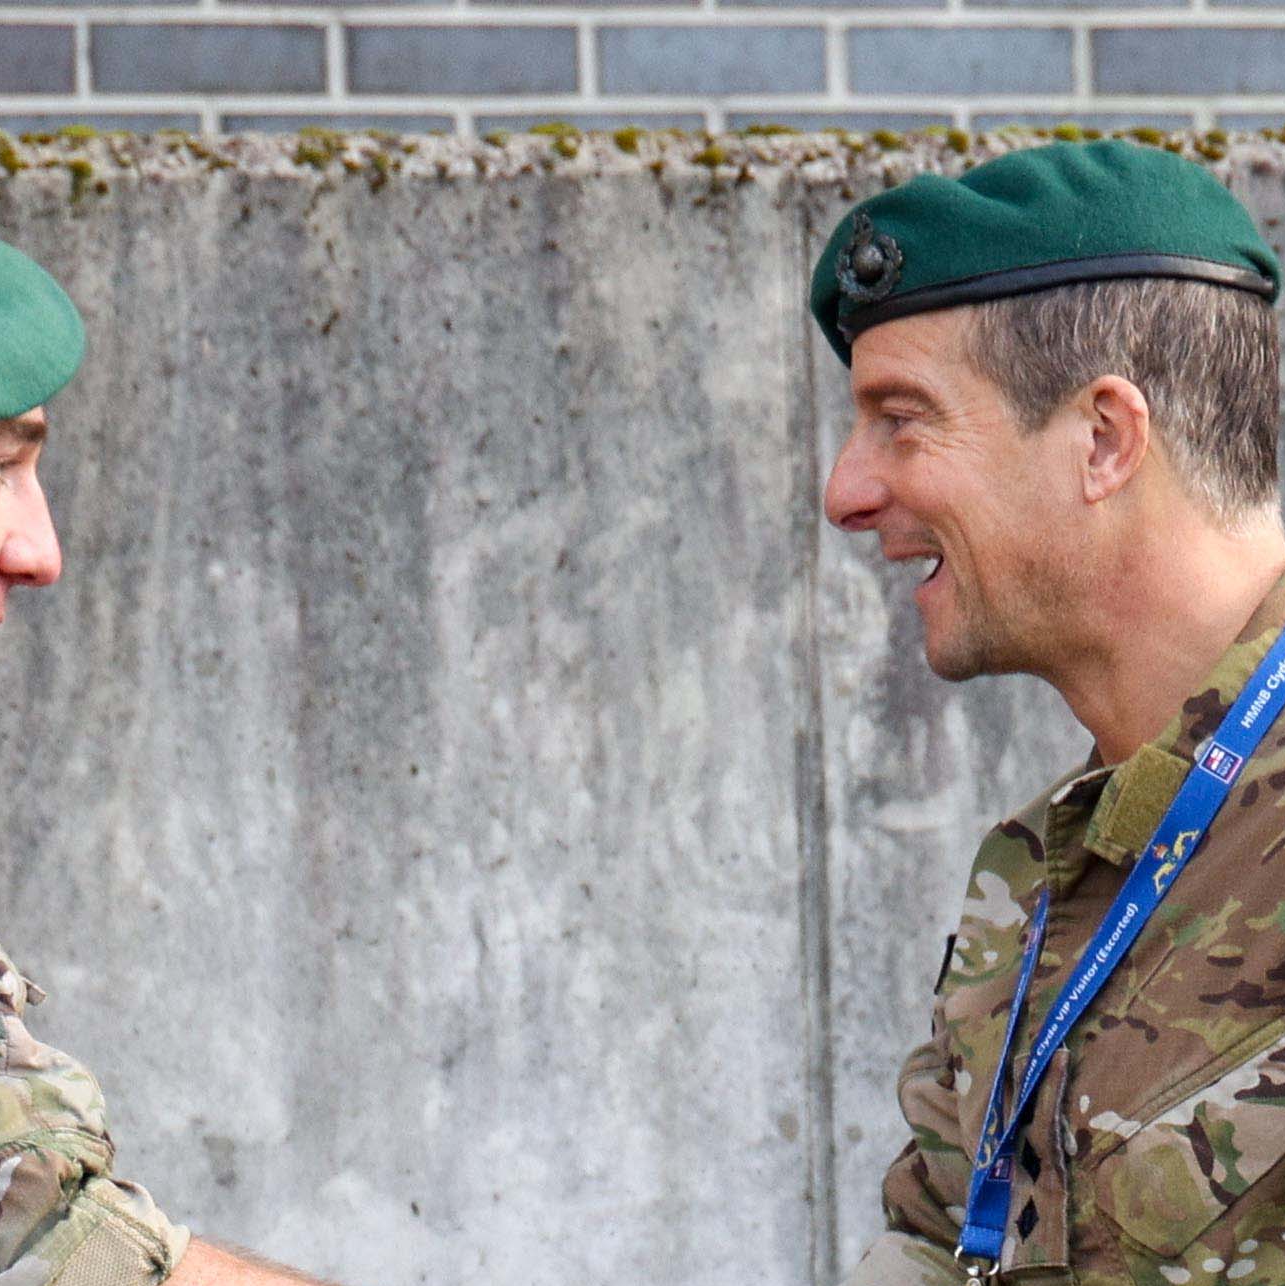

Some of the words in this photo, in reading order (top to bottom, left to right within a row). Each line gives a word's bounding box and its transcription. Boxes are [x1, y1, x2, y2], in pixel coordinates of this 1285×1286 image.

[1240, 689, 1272, 729] HMNB
[1036, 1023, 1058, 1057] Clyde
[1055, 1001, 1071, 1022] VIP
[1069, 962, 1099, 1002] Visitor
[1097, 902, 1139, 963] (Escorted)
